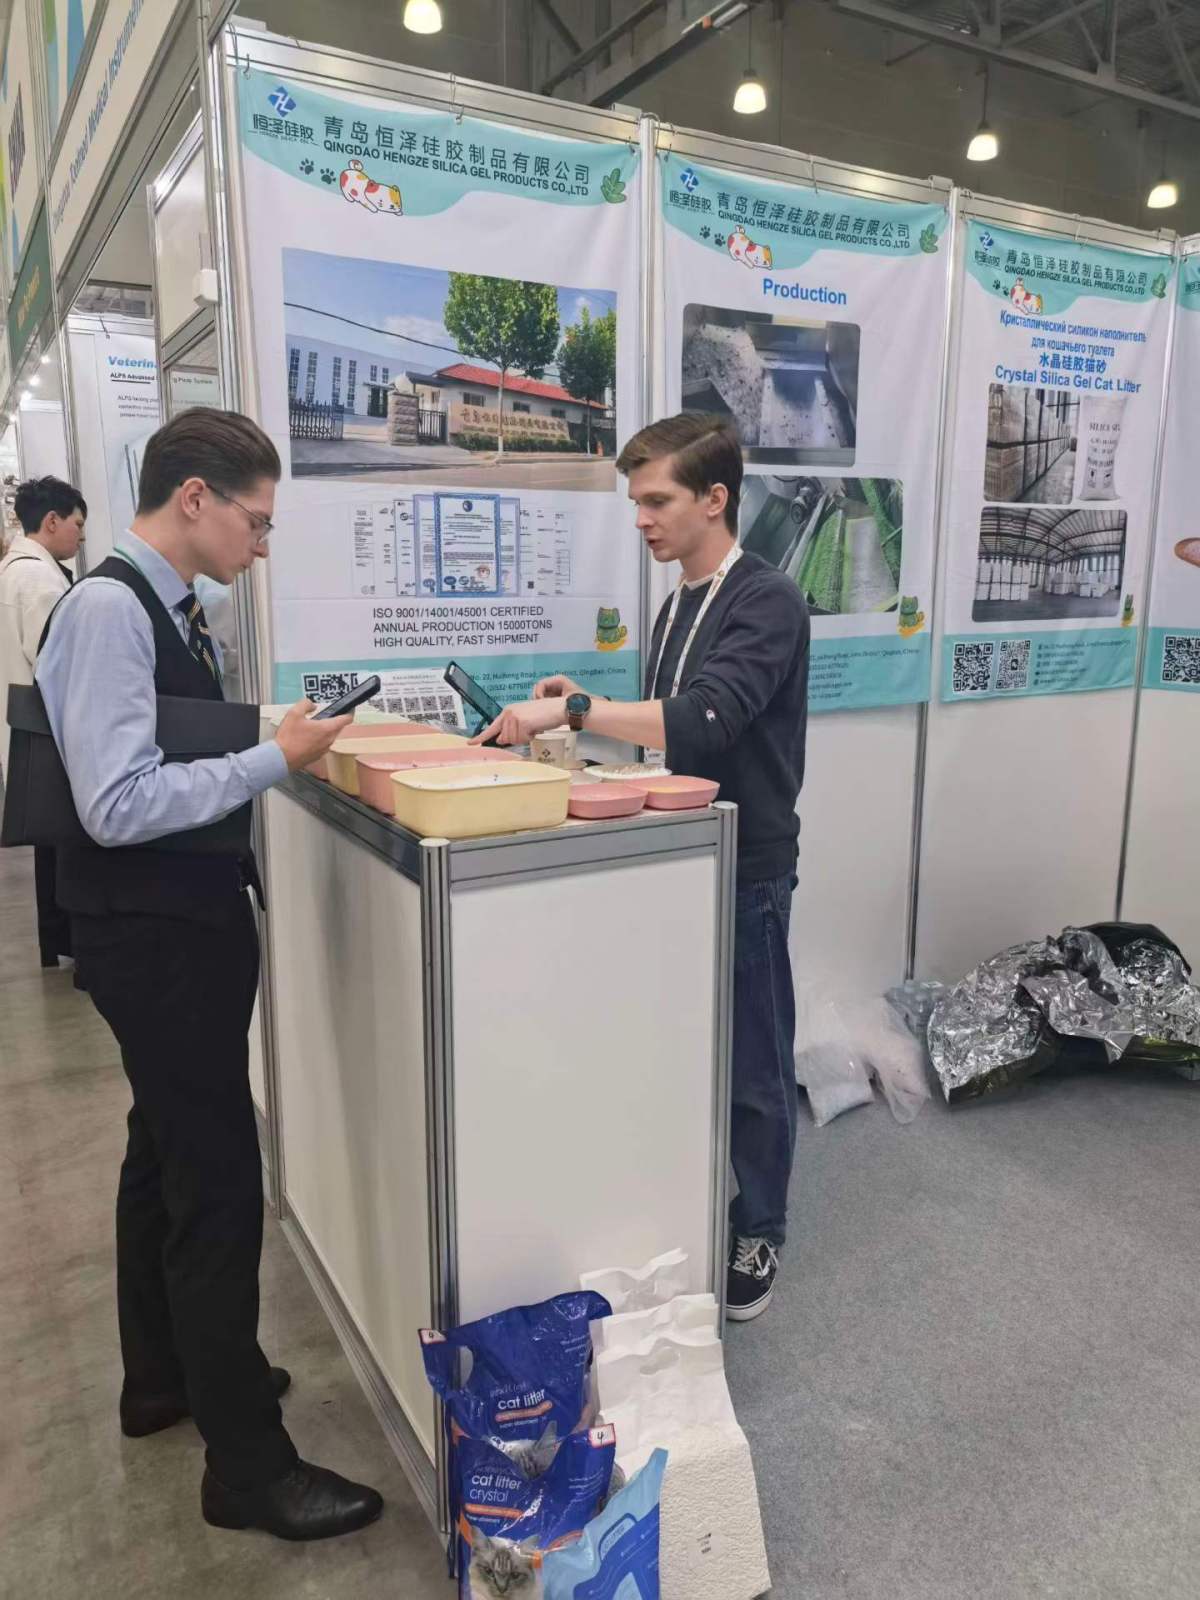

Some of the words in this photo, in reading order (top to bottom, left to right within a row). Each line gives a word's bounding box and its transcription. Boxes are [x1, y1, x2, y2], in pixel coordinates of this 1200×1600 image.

[323, 115, 589, 185] 青岛恒泽硅胶制品有限公司
[324, 140, 380, 160] QINGDAO
[383, 150, 429, 169] HENGZE
[432, 159, 468, 176] SILICA
[469, 165, 491, 180] GEL
[493, 170, 550, 190] PRODUCTS
[551, 180, 590, 197] CO.,LTD
[716, 191, 910, 240] 青岛恒泽硅胶制品有限公司
[718, 209, 756, 227] QINGDAO
[757, 219, 789, 233] HENGZE
[790, 225, 817, 239] SILICA
[818, 230, 834, 241] GEL
[835, 232, 878, 247] PRODUCTS
[1004, 264, 1036, 278] QINGDAO
[1037, 270, 1061, 282] HENGZE
[1062, 275, 1081, 285] SILICA
[1081, 277, 1092, 287] GEL
[1093, 280, 1124, 292] PRODUCTS
[763, 277, 847, 305] Production
[1039, 352, 1107, 374] 水晶硅胶猫砂
[995, 364, 1037, 384] Crystal
[1040, 370, 1071, 386] Silica
[1073, 374, 1093, 389] Gel
[1094, 376, 1114, 391] Cat
[1116, 379, 1142, 394] Litter
[373, 607, 393, 619] ISO
[395, 606, 488, 619] 9001/14001/45001
[490, 605, 545, 617] CERTIFIED
[373, 622, 420, 633] ANNUAL
[422, 620, 495, 632] PRODUCTION
[498, 619, 553, 631] 15000TONS
[374, 636, 403, 648] HIGH
[405, 635, 454, 647] QUALITY,
[456, 635, 484, 645] FAST
[486, 633, 540, 645] SHIPMENT
[497, 1395, 521, 1410] cat
[522, 1388, 546, 1408] litter
[471, 1474, 493, 1487] cat
[495, 1475, 523, 1490] litter
[469, 1488, 510, 1503] crystal
